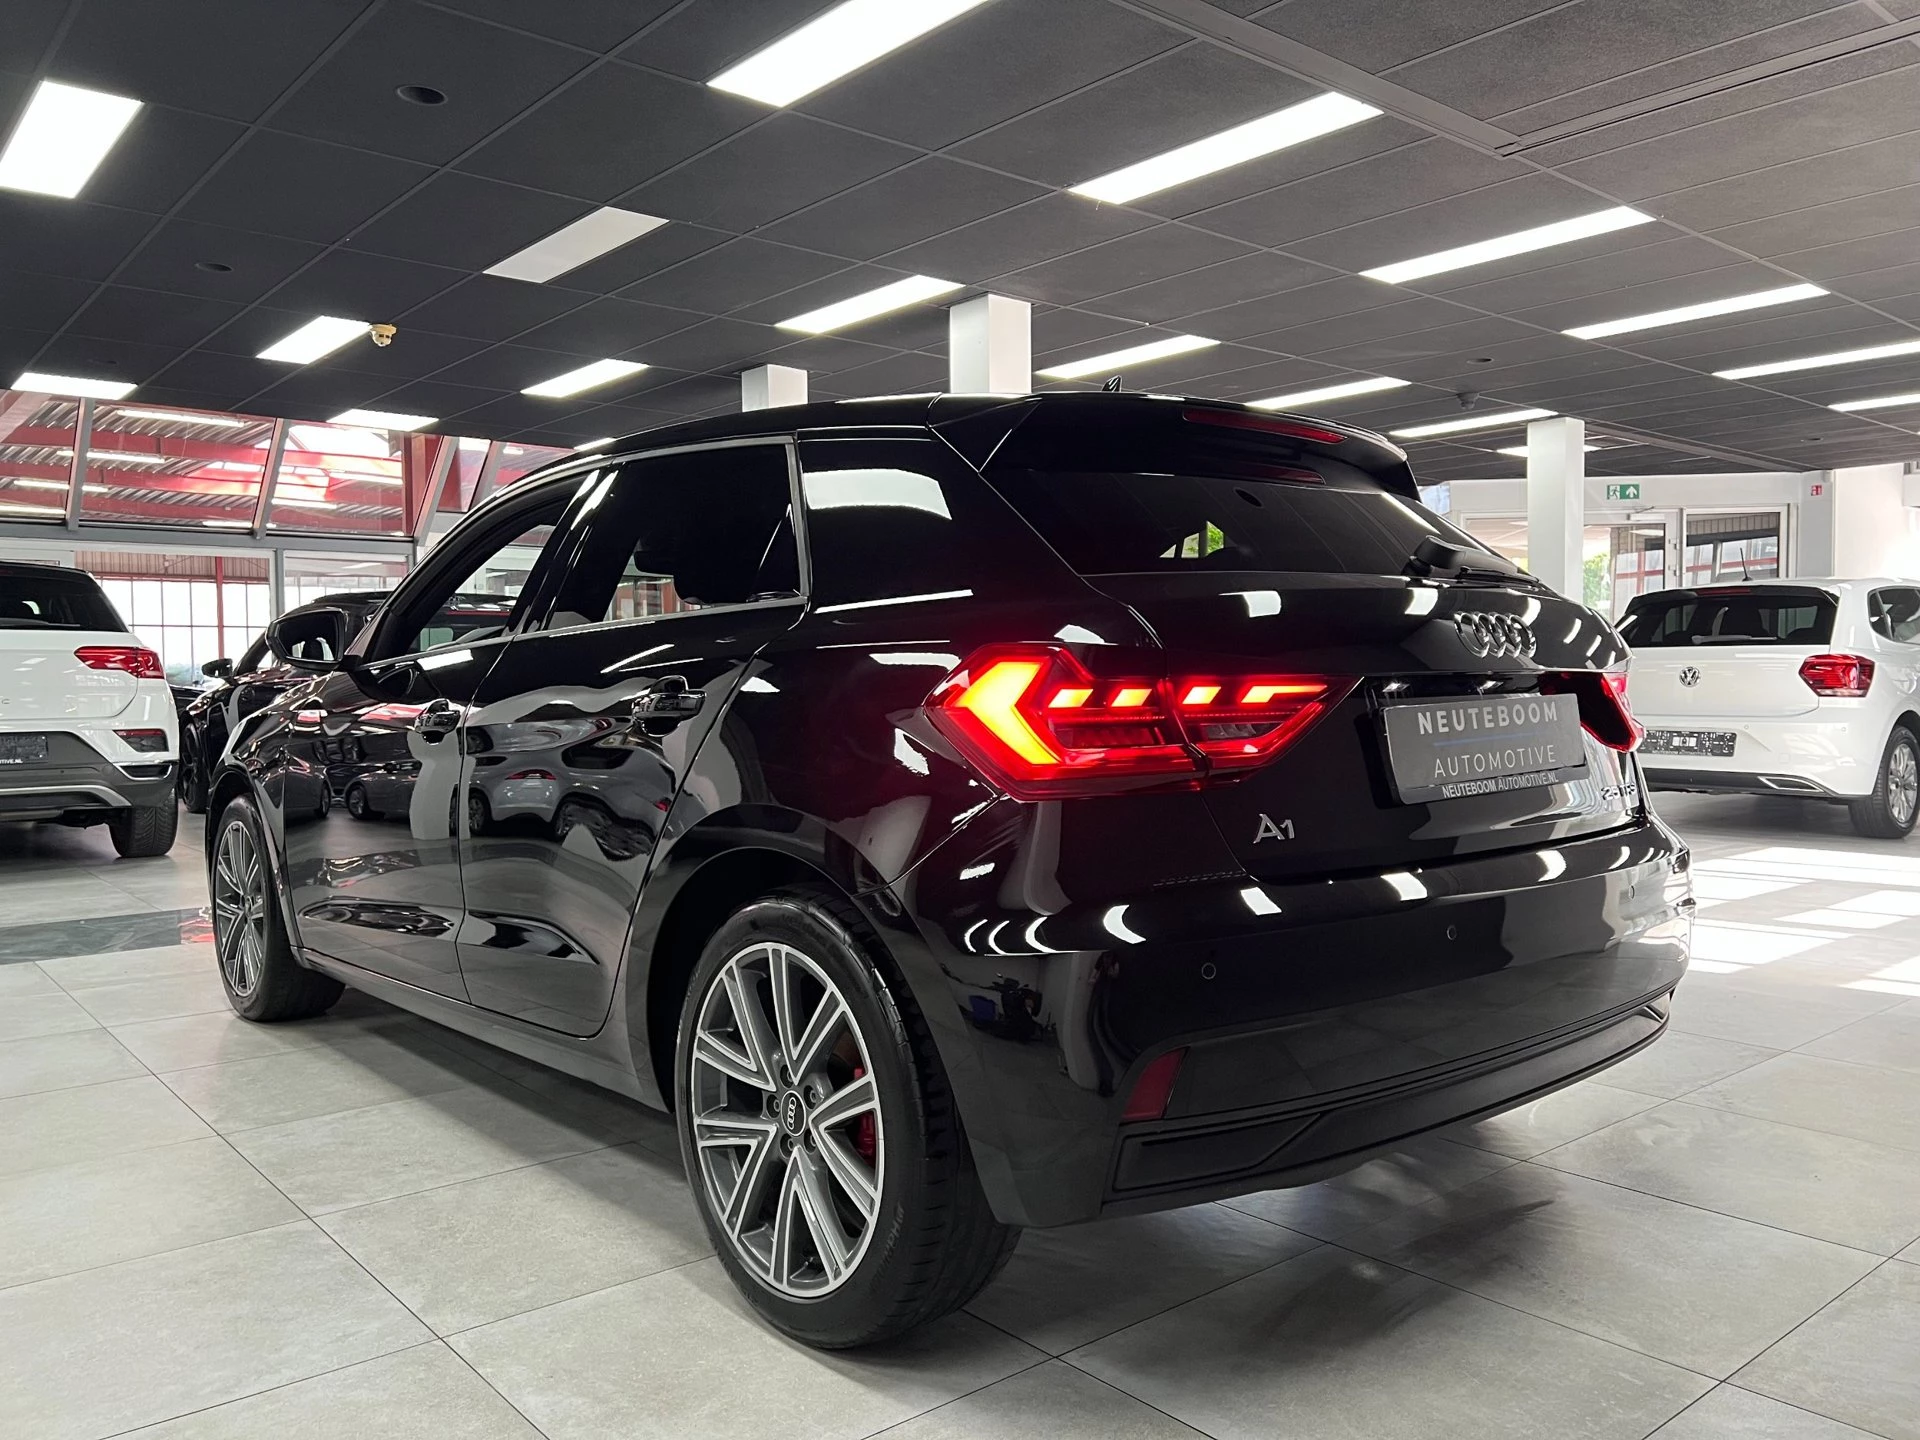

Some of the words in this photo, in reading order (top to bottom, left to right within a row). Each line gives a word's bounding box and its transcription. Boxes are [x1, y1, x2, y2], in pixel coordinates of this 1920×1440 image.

[1417, 702, 1558, 735] NEUTEBOOM
[1434, 744, 1556, 778] AUTOMOTIVE
[1442, 779, 1497, 799] NEUTEBOOM
[1498, 771, 1559, 791] AUTOMOTIVE.NL
[1253, 813, 1295, 844] A1
